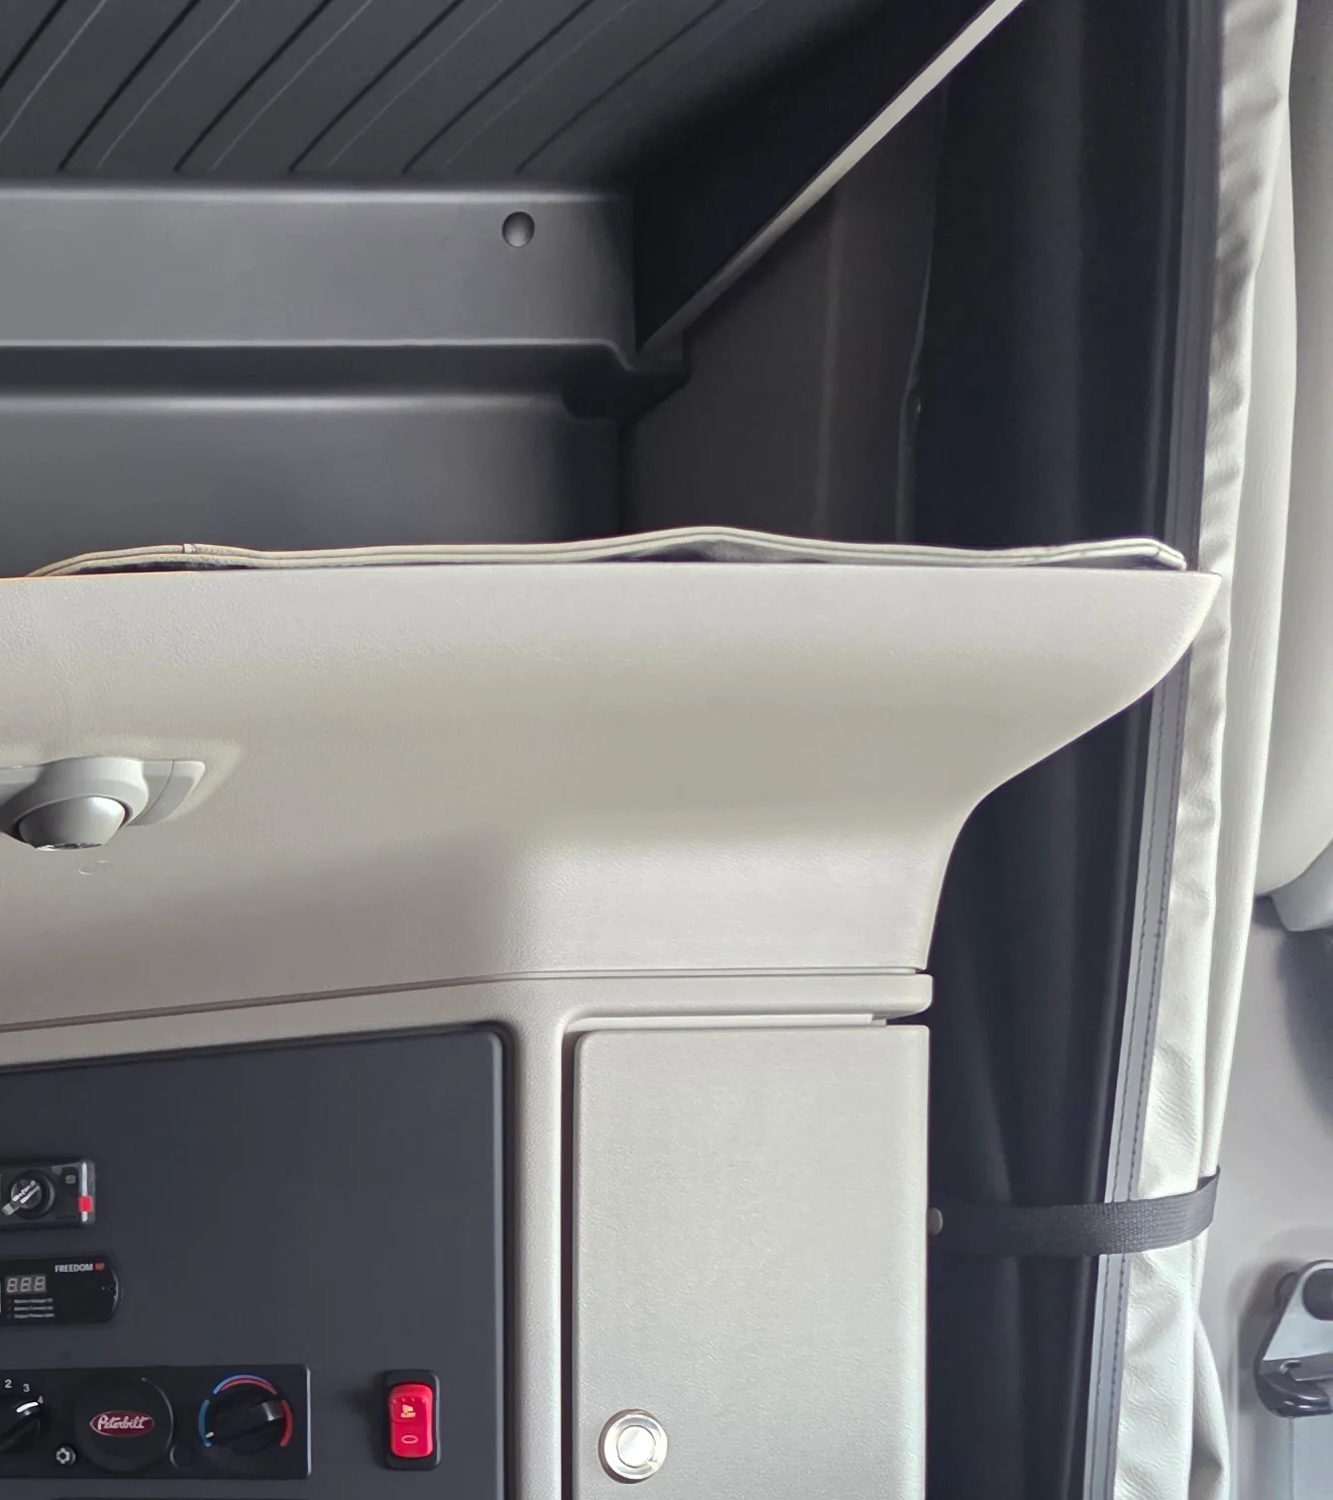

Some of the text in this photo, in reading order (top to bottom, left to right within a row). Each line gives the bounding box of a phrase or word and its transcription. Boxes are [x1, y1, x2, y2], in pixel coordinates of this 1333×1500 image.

[54, 1263, 93, 1273] FREEDOM
[4, 1379, 12, 1388] 2
[22, 1383, 30, 1392] 3
[97, 1414, 149, 1430] Peterbilt
